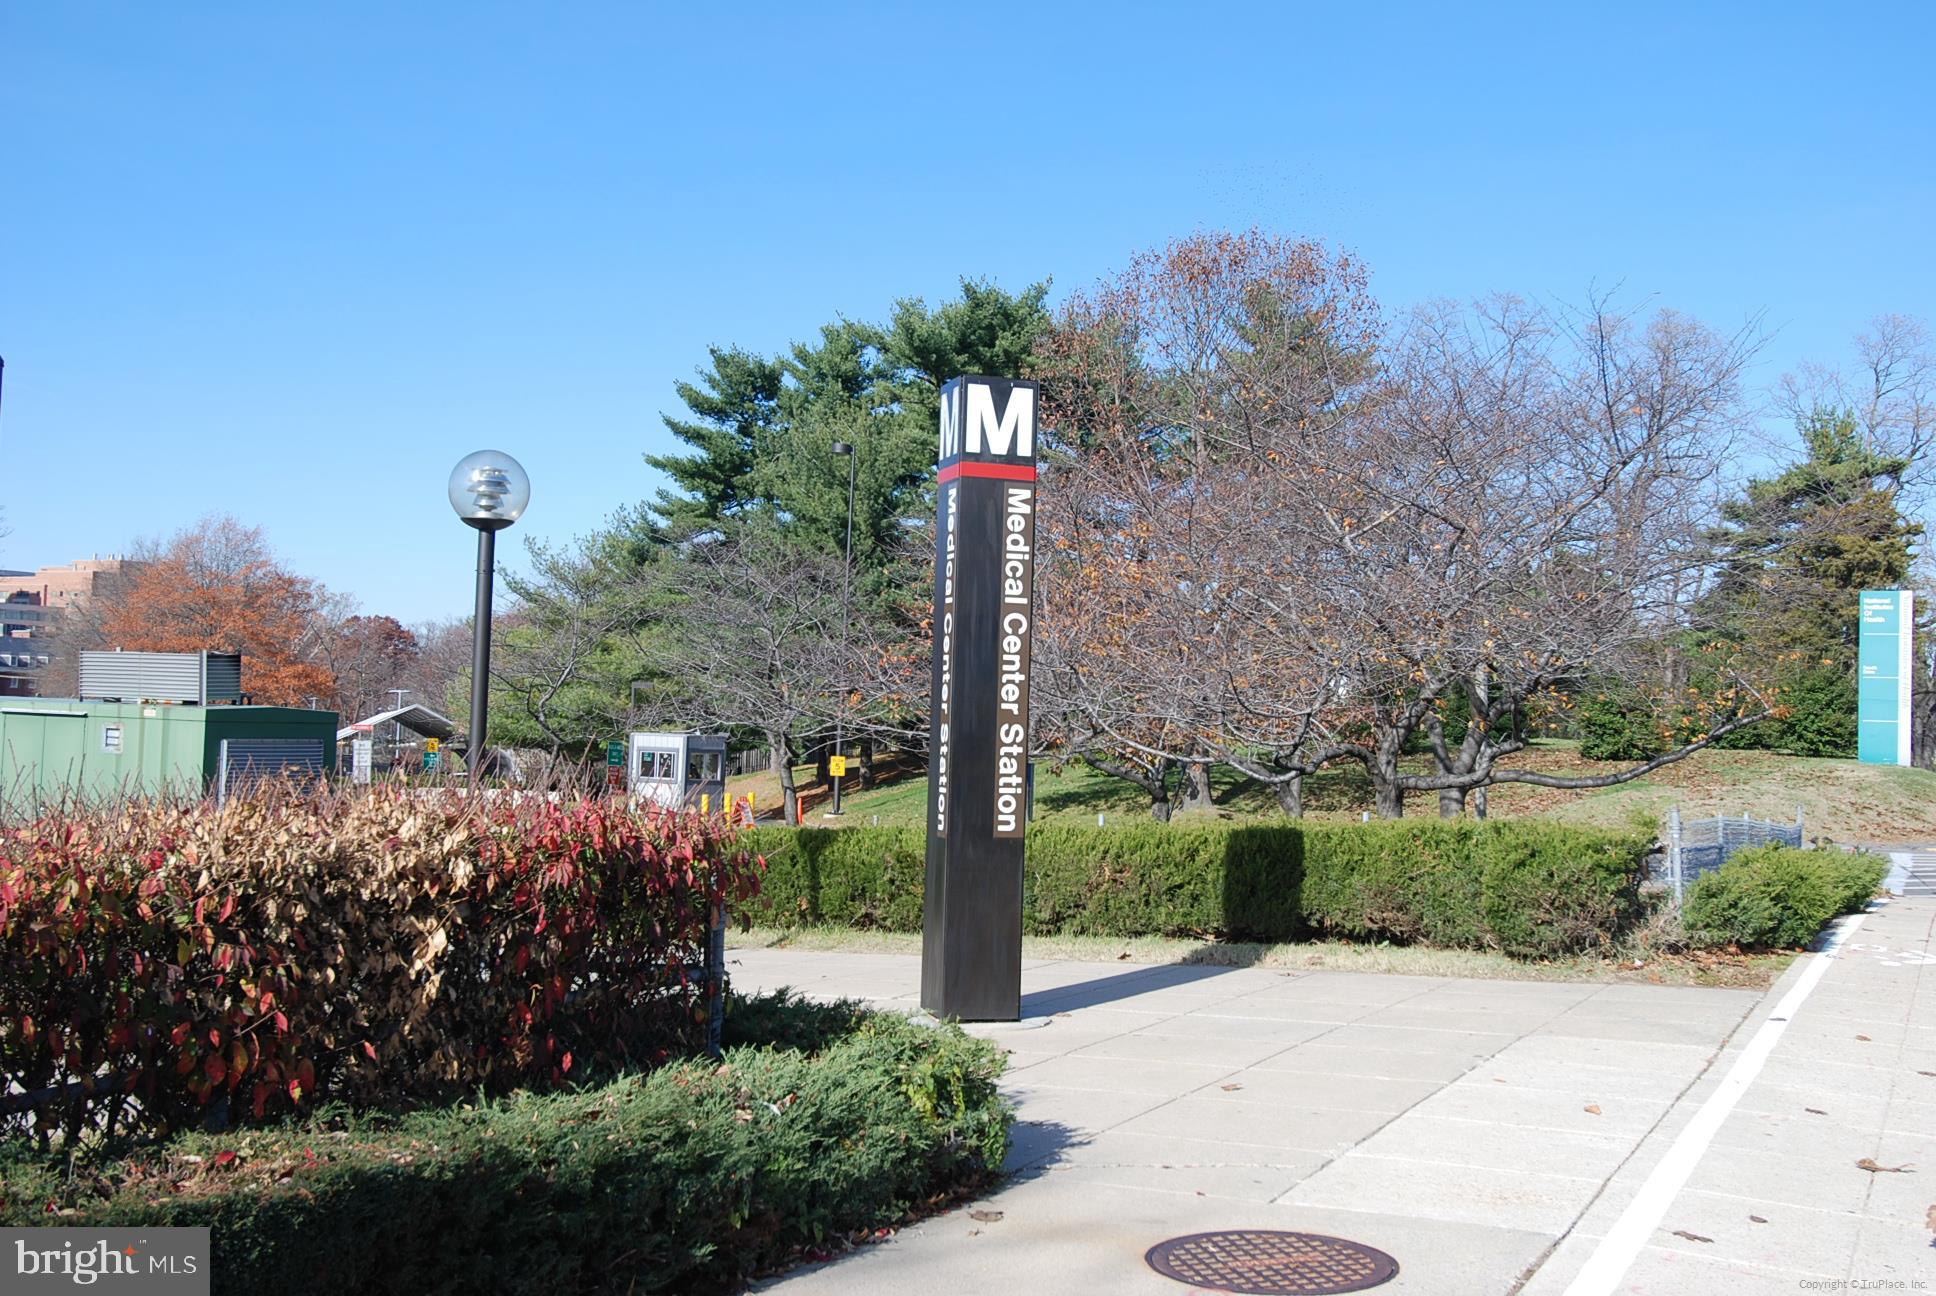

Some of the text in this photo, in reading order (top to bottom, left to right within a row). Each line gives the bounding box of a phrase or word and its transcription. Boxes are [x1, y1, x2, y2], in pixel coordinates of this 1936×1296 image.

[939, 386, 959, 461] M
[965, 383, 1034, 457] M
[997, 488, 1032, 832] Medical Center Station
[937, 723, 949, 831] Station
